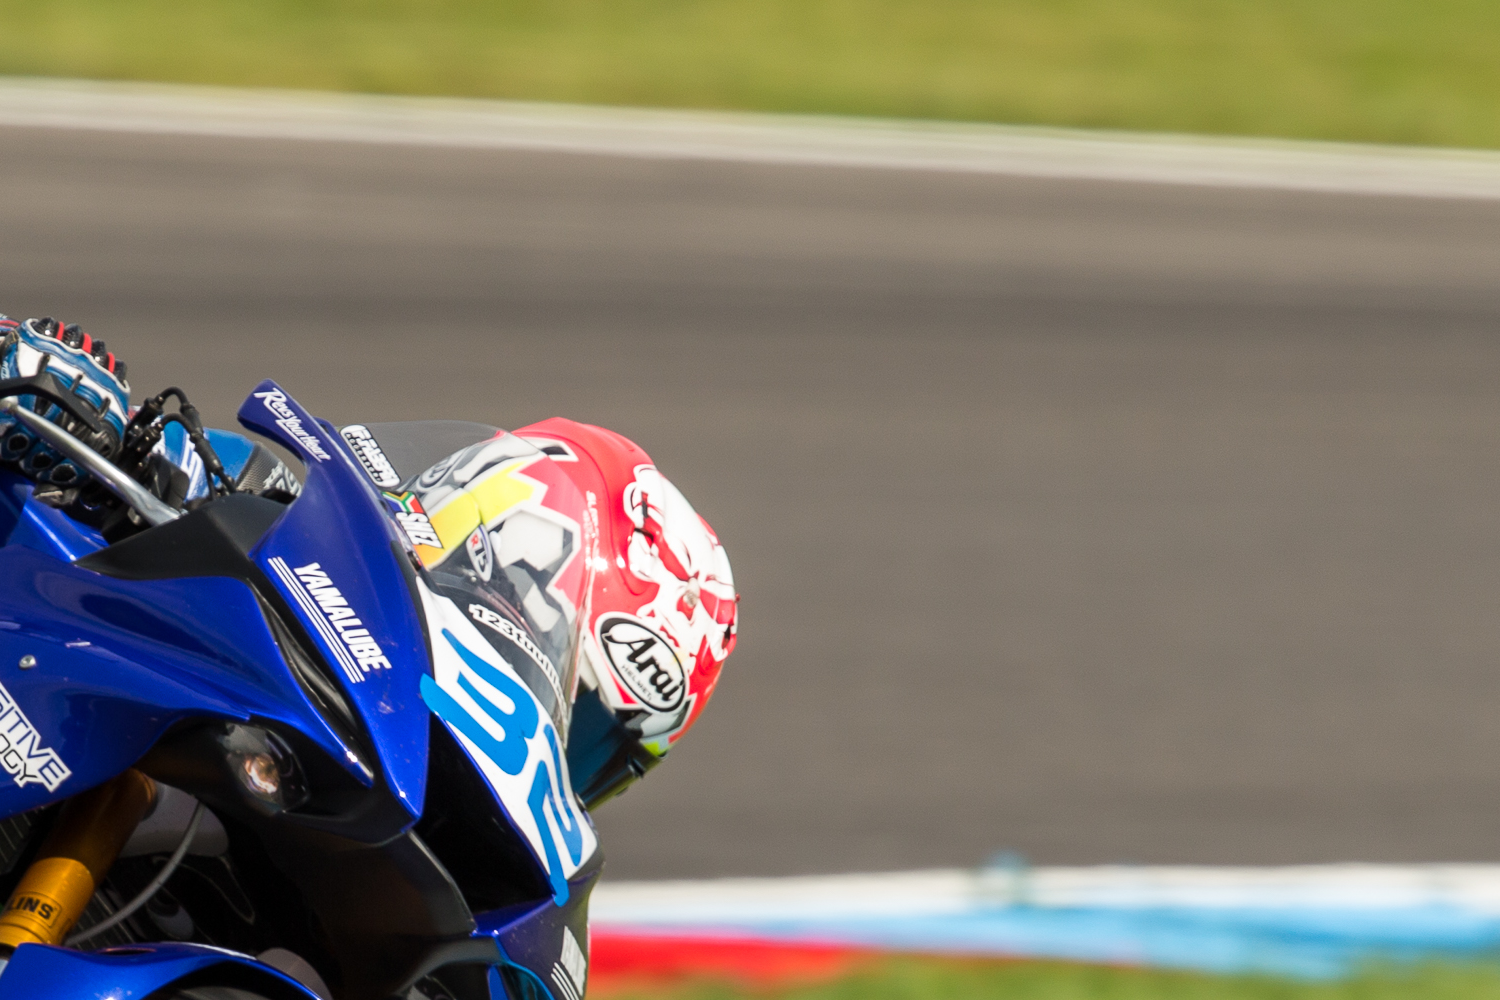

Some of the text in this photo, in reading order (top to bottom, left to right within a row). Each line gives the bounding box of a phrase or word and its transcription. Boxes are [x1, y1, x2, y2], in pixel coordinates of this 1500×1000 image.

[253, 387, 296, 420] Revs
[300, 435, 332, 461] Heart
[294, 562, 392, 671] YAMALUBE
[603, 637, 684, 702] Arai
[419, 629, 583, 905] 32
